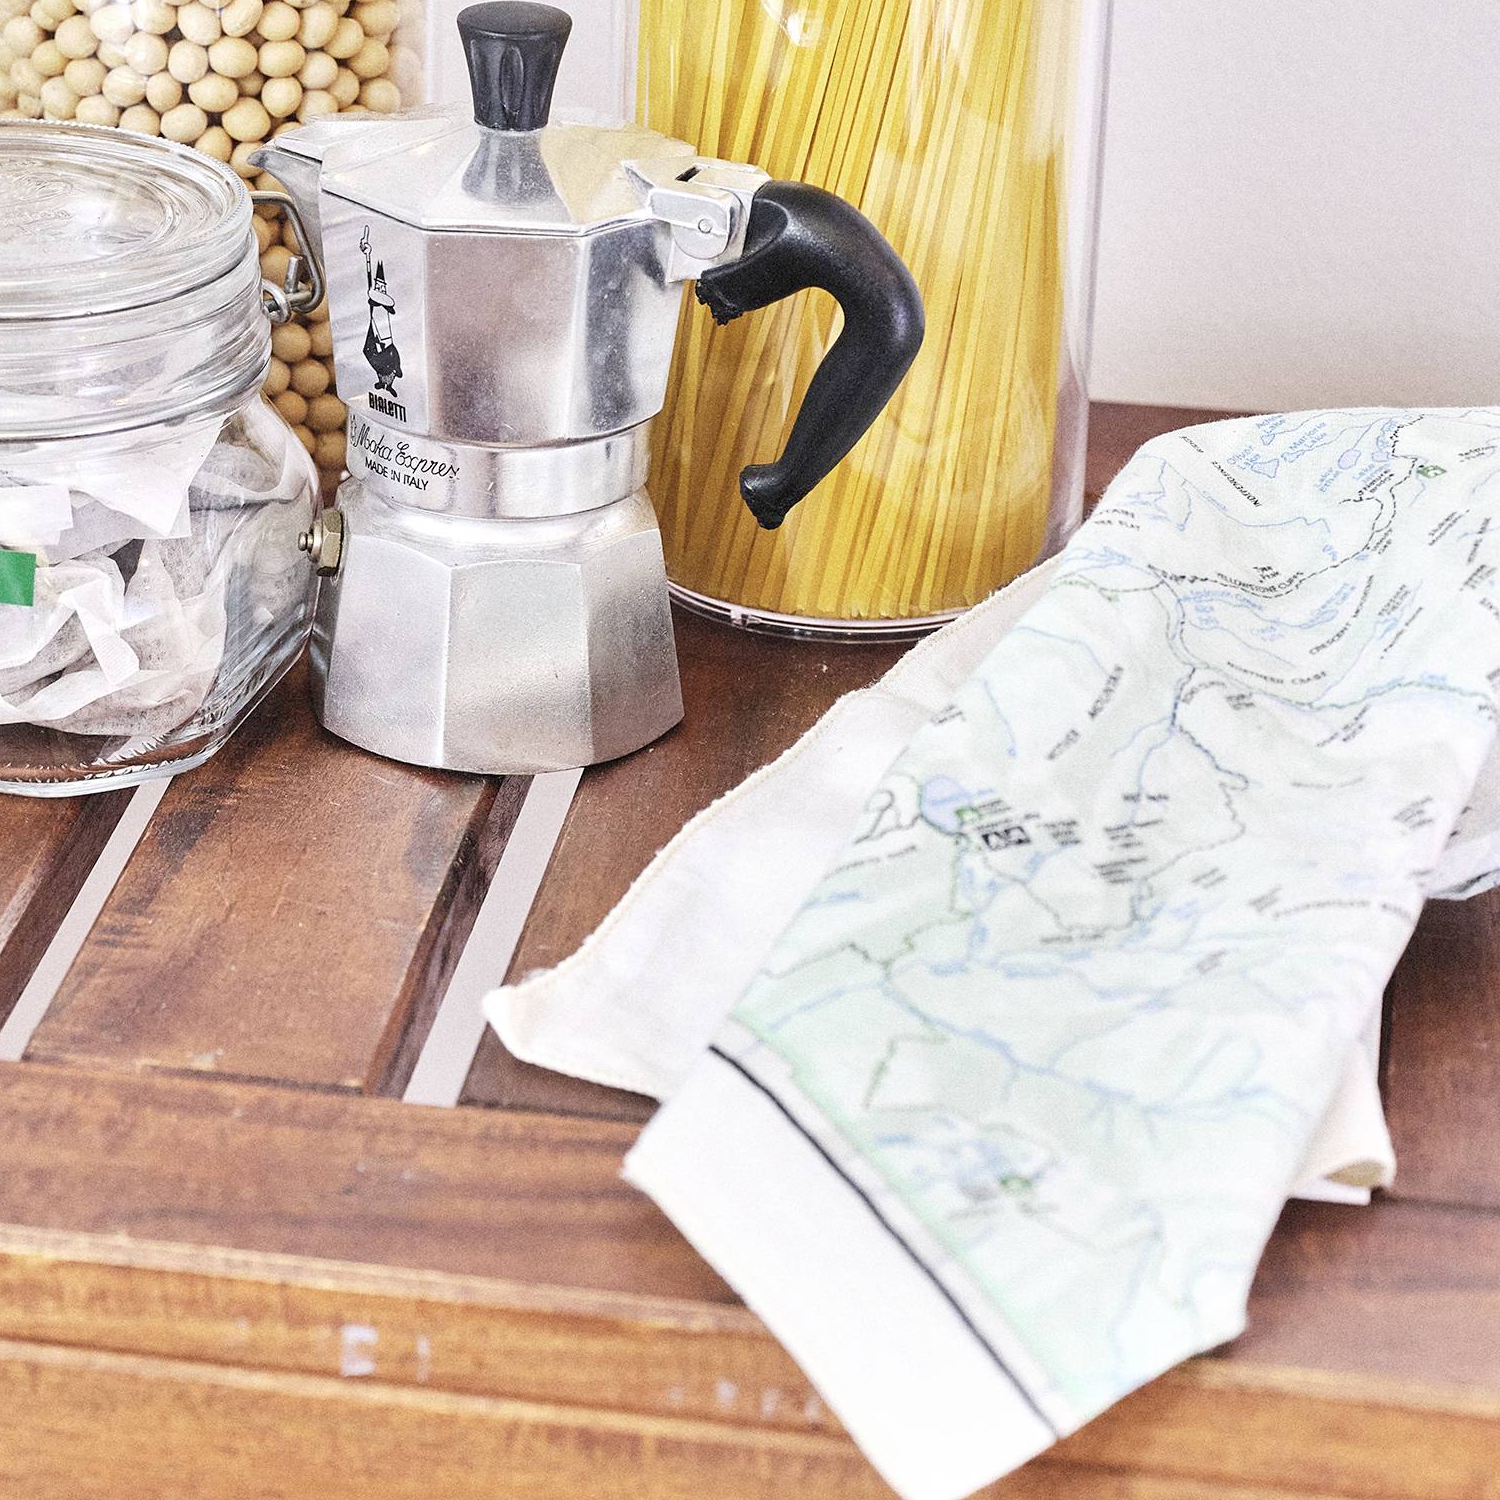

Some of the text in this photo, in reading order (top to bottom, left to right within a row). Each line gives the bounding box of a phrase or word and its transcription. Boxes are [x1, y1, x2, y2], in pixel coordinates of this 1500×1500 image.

[368, 392, 407, 423] BIALETTI
[353, 423, 393, 462] Moka
[364, 456, 429, 492] MADE IN ITALY
